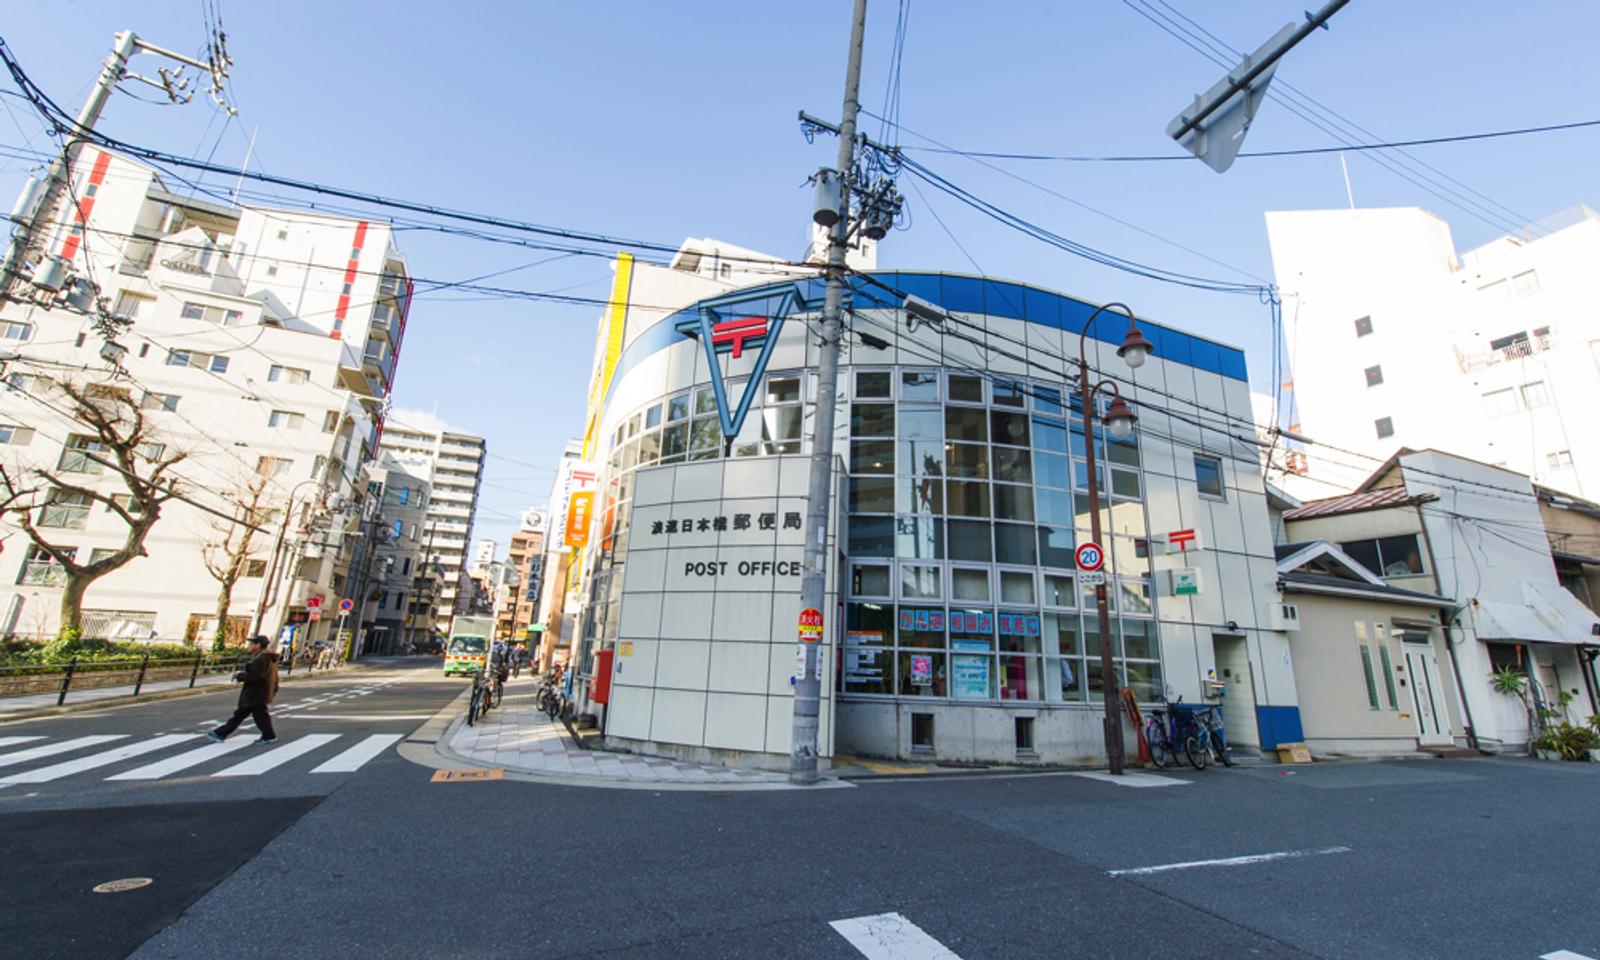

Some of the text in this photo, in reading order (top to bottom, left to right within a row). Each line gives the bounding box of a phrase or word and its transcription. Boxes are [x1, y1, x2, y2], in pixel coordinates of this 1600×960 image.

[1082, 551, 1097, 564] 20
[685, 561, 801, 576] POST OFFICE
